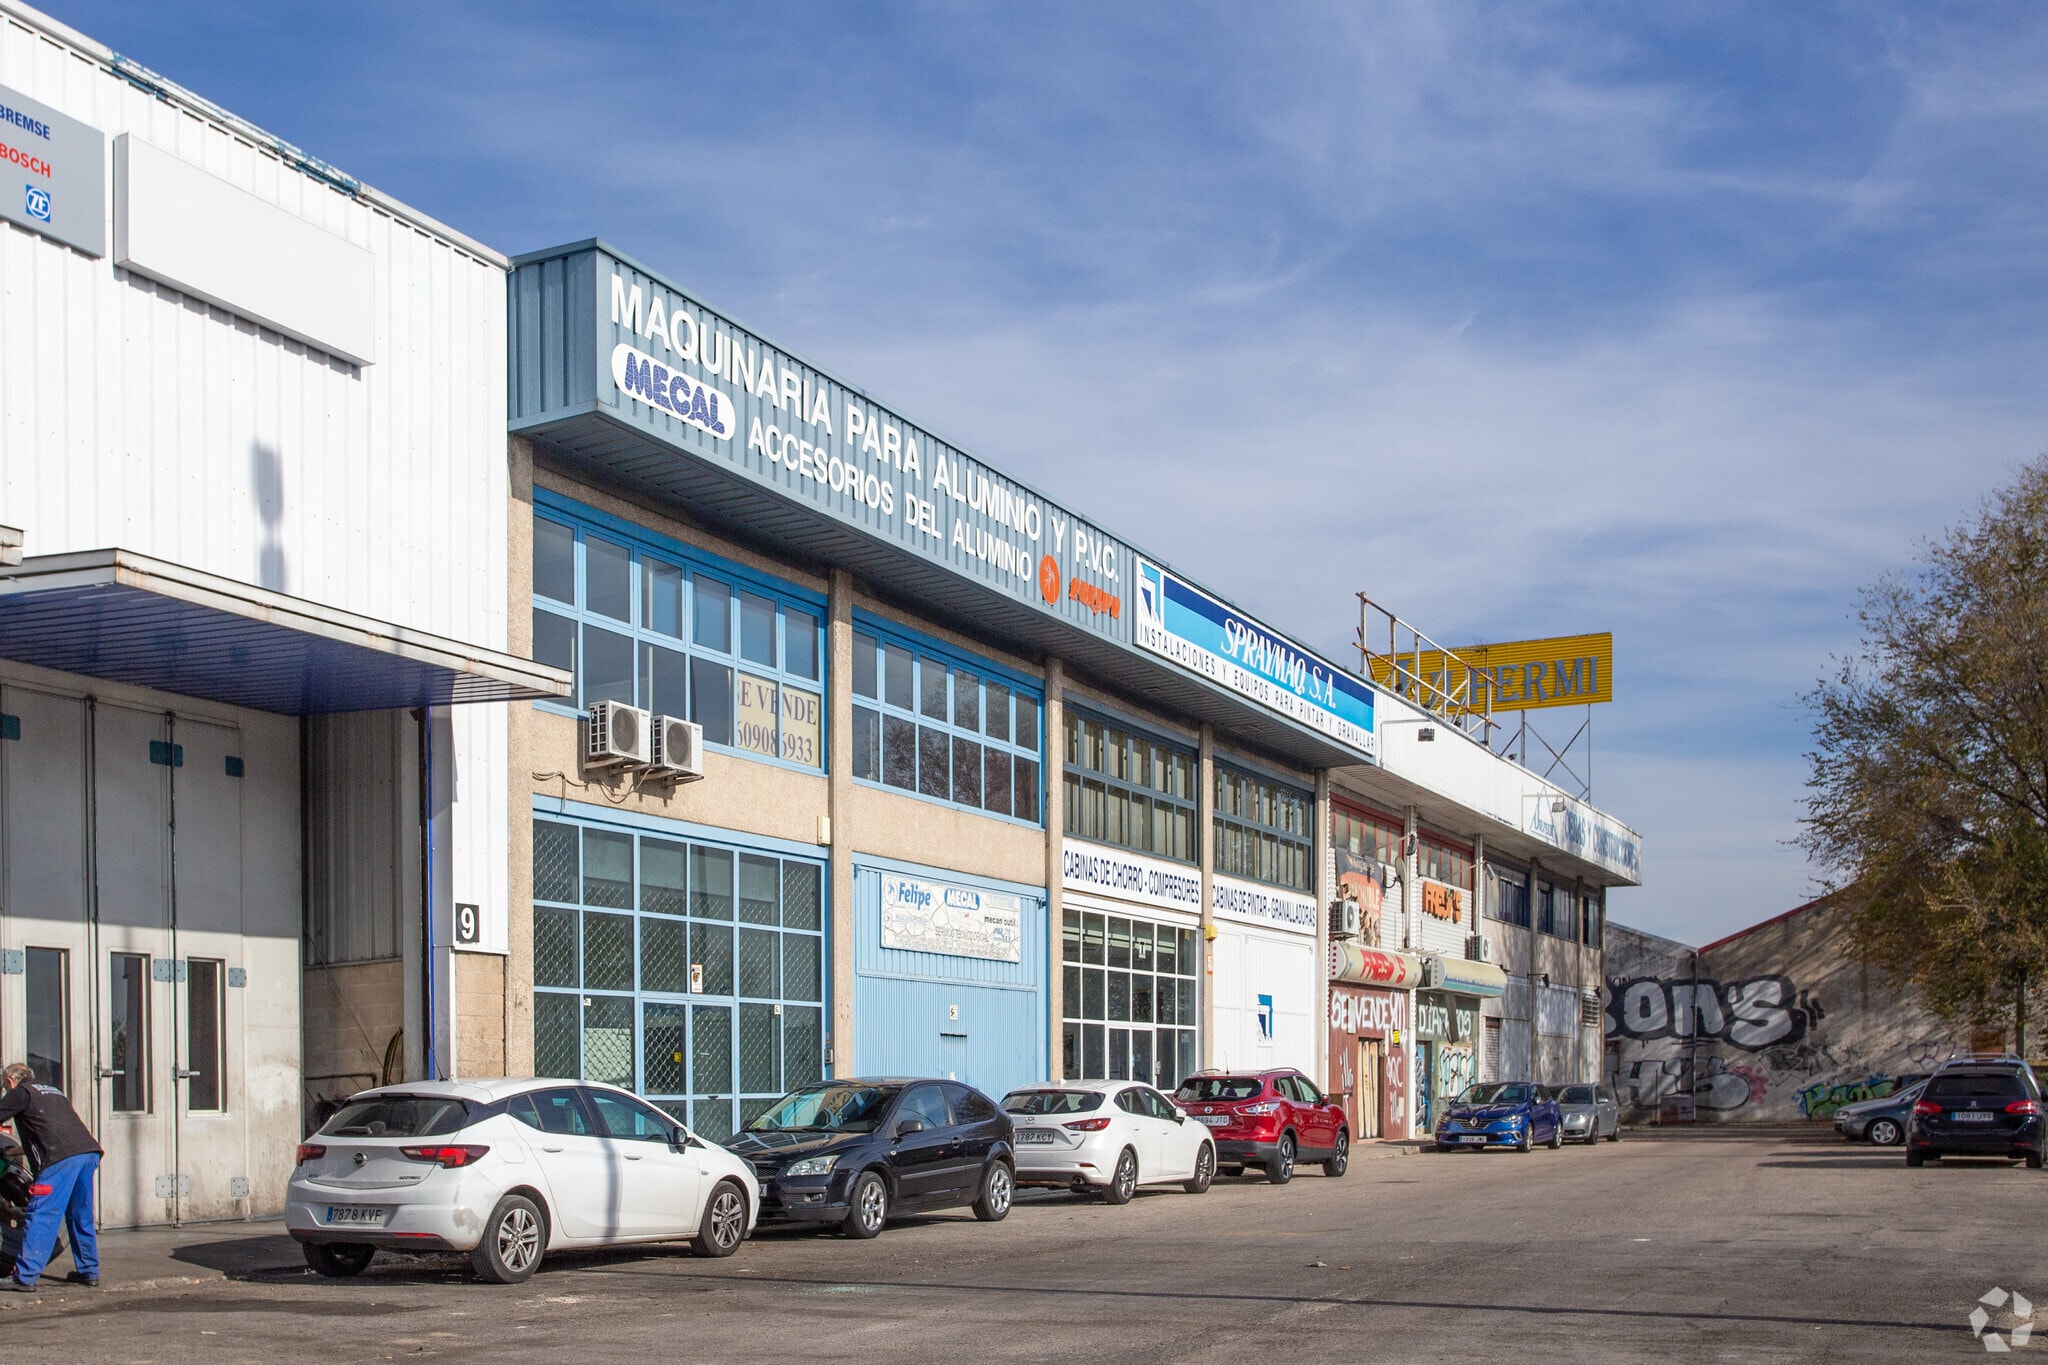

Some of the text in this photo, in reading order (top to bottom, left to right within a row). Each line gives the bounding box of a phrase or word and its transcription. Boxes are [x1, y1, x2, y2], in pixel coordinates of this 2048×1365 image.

[0, 143, 51, 178] BOSCH
[625, 352, 725, 435] MECAL
[611, 273, 1119, 582] MAQUINARIA PARA ALUMINIO Y P.V.C.
[748, 416, 1032, 582] ACCESORIOS DEL ALUMINIO
[1220, 618, 1307, 696] SPRAYMAQ
[1139, 622, 1374, 750] INSTALACIONES Y EQUIPOS PARA PINTAR Y GRANALLAR
[898, 882, 932, 911] Felipe
[946, 888, 977, 910] MECAL
[1064, 850, 1099, 884] CABINAS
[1100, 858, 1110, 886] DE
[1112, 862, 1143, 893] CHORRO
[1149, 870, 1199, 904] COMPRESORES
[1212, 884, 1238, 912] CABINAS
[1239, 890, 1246, 914] DE
[1247, 892, 1267, 917] PINTAR
[461, 907, 475, 940] 9
[1036, 1133, 1052, 1141] KCY
[333, 1208, 382, 1221] 7878 KVF
